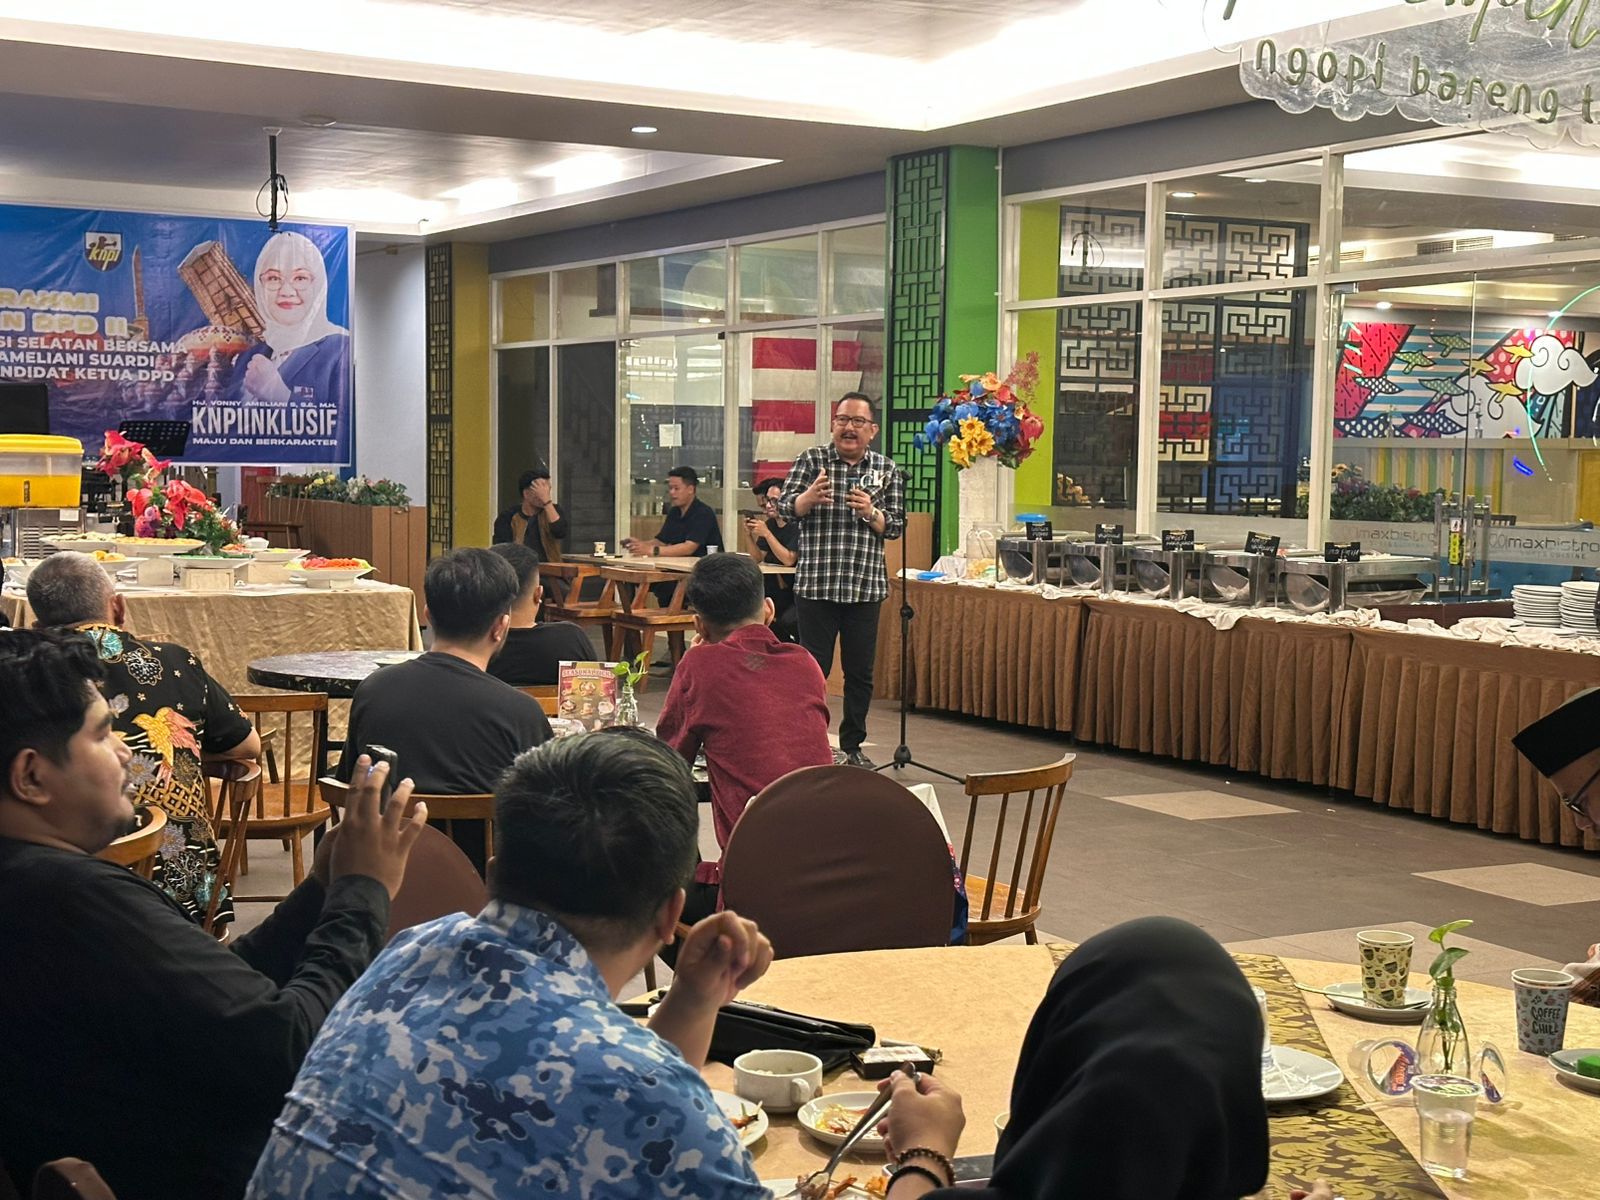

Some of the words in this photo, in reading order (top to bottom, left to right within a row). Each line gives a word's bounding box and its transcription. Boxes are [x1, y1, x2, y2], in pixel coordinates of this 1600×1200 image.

[1256, 39, 1386, 94] ngopi
[1411, 55, 1559, 124] bareng
[17, 337, 98, 350] SELATAN
[103, 340, 188, 354] BERSAMA
[0, 351, 84, 365] AMELIANI
[89, 353, 155, 367] SUARDI
[0, 366, 69, 379] NDIDAT
[75, 367, 133, 380] KETUA
[138, 369, 175, 382] DPD
[192, 406, 338, 435] KNPIINKLUSIF
[255, 438, 338, 446] BERKARAKTER
[1507, 536, 1600, 552] maxbistro
[1531, 1006, 1561, 1020] COFFEE
[1531, 1021, 1559, 1036] CHILL
